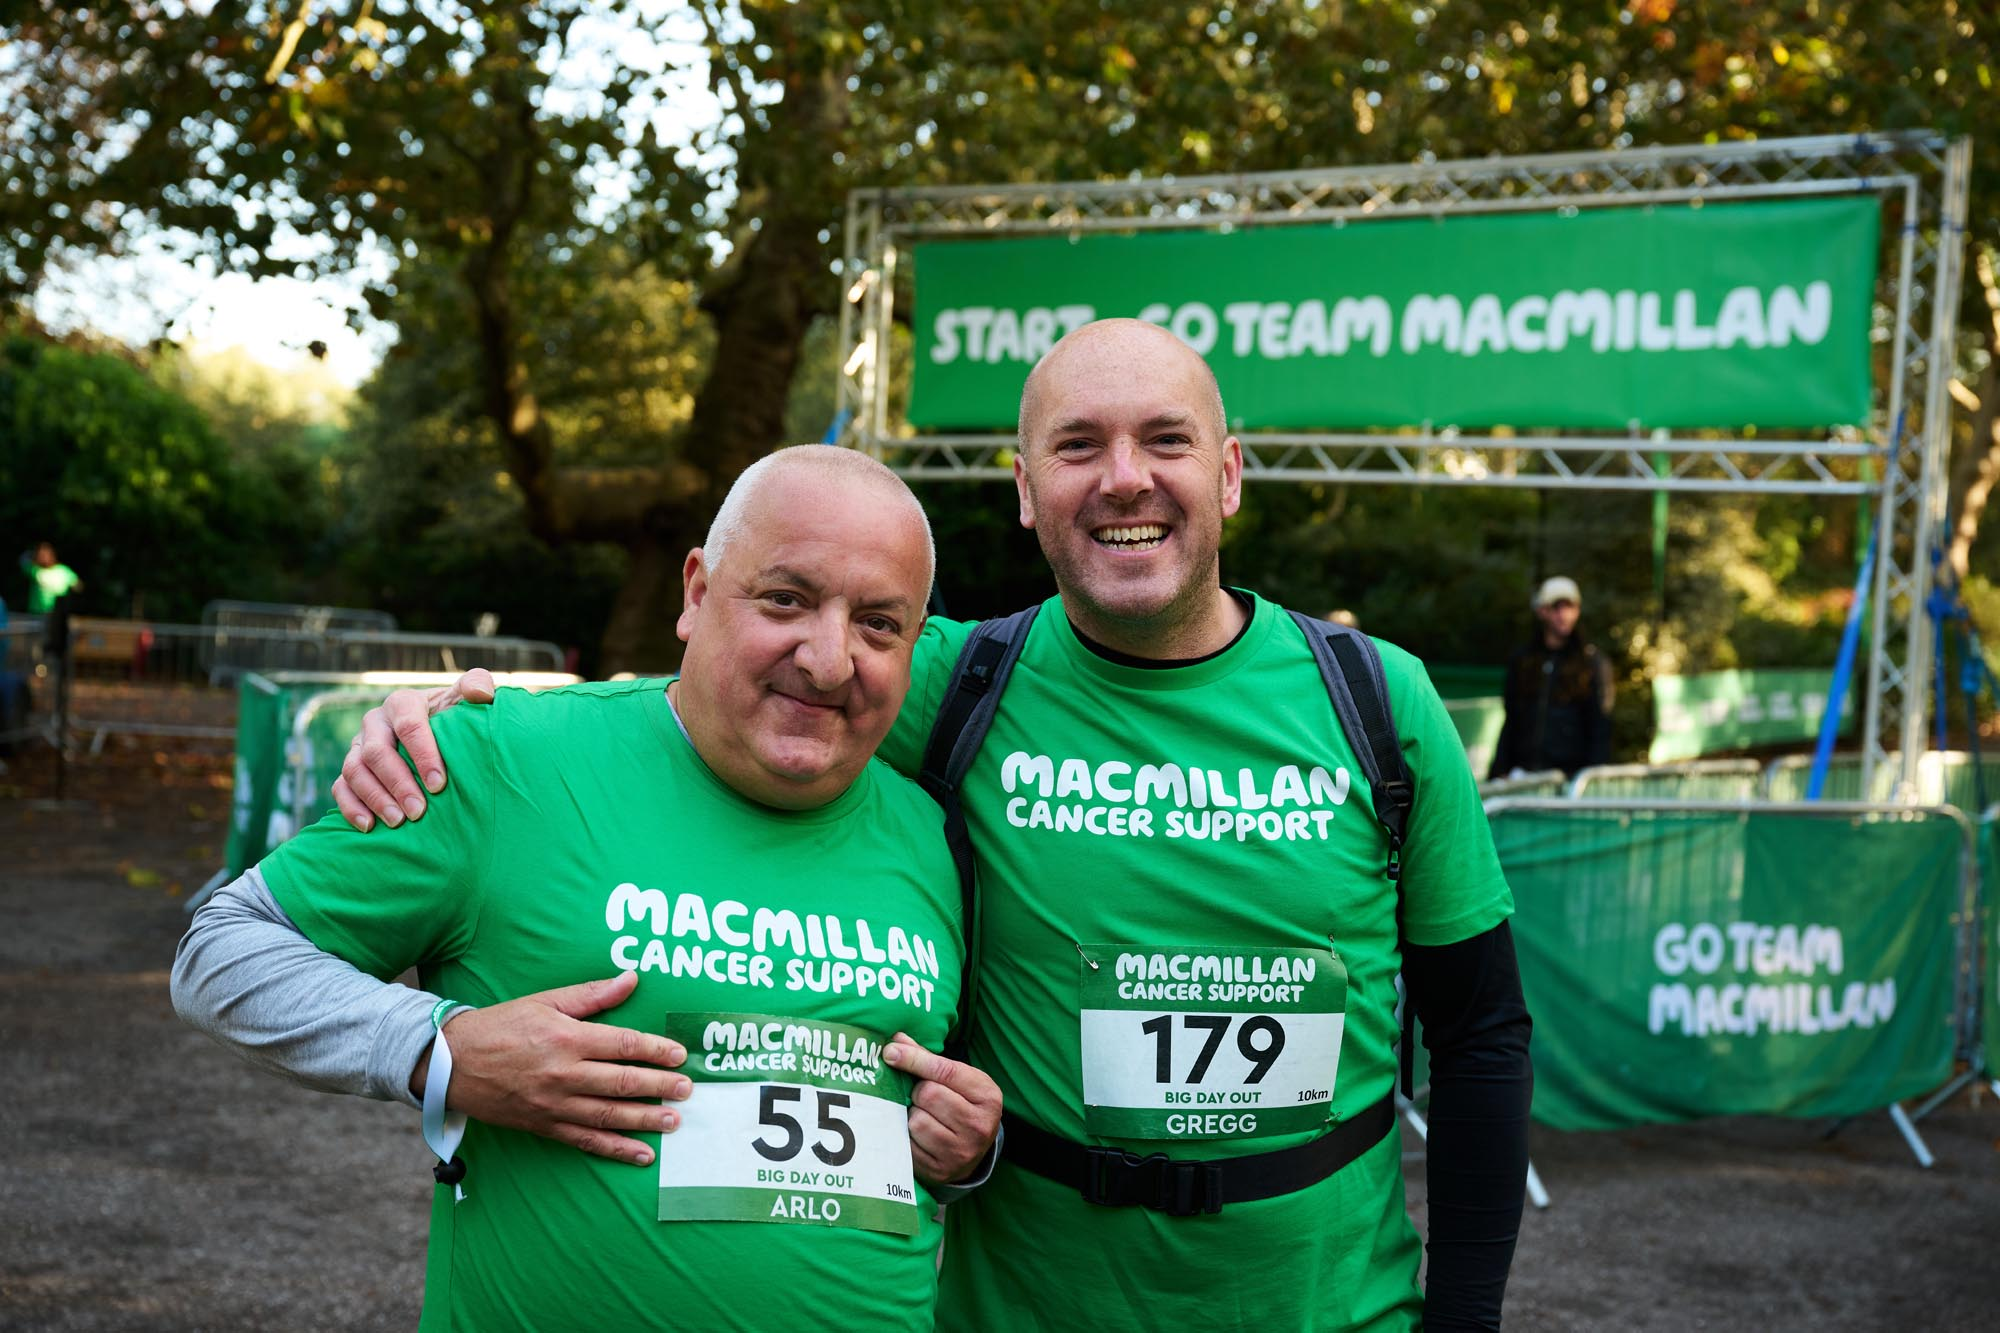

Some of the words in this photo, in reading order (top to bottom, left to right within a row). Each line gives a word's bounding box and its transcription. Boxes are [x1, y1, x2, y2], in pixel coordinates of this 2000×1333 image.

[1224, 296, 1392, 358] TEAM
[1401, 281, 1832, 356] MACMILLAN
[1000, 751, 1351, 810] MACMILLAN
[1006, 797, 1154, 837] CANCER
[1165, 810, 1334, 842] SUPPORT
[605, 882, 940, 979] MACMILLAN
[1653, 922, 1725, 976] GO
[1727, 921, 1844, 977] TEAM
[610, 936, 774, 989] CANCER
[785, 960, 935, 1013] SUPPORT
[1115, 953, 1316, 983] MACMILLAN
[1118, 982, 1203, 1001] CANCER
[1208, 983, 1304, 1003] SUPPORT
[1648, 977, 1897, 1037] MACMILLAN
[702, 1021, 882, 1069] MACMILLAN
[1141, 1014, 1286, 1085] 179
[704, 1052, 797, 1072] CANCER
[801, 1056, 878, 1086] SUPPORT
[1165, 1092, 1192, 1104] BIG
[1196, 1091, 1225, 1104] DAY
[1229, 1091, 1262, 1104] OUT
[1297, 1088, 1329, 1103] 10km
[751, 1085, 856, 1167] 55
[1166, 1113, 1258, 1135] GREGG
[756, 1169, 786, 1183] BIG
[790, 1171, 820, 1185] DAY
[824, 1174, 854, 1189] OUT
[886, 1183, 913, 1200] 10km
[769, 1194, 842, 1222] ARLO
